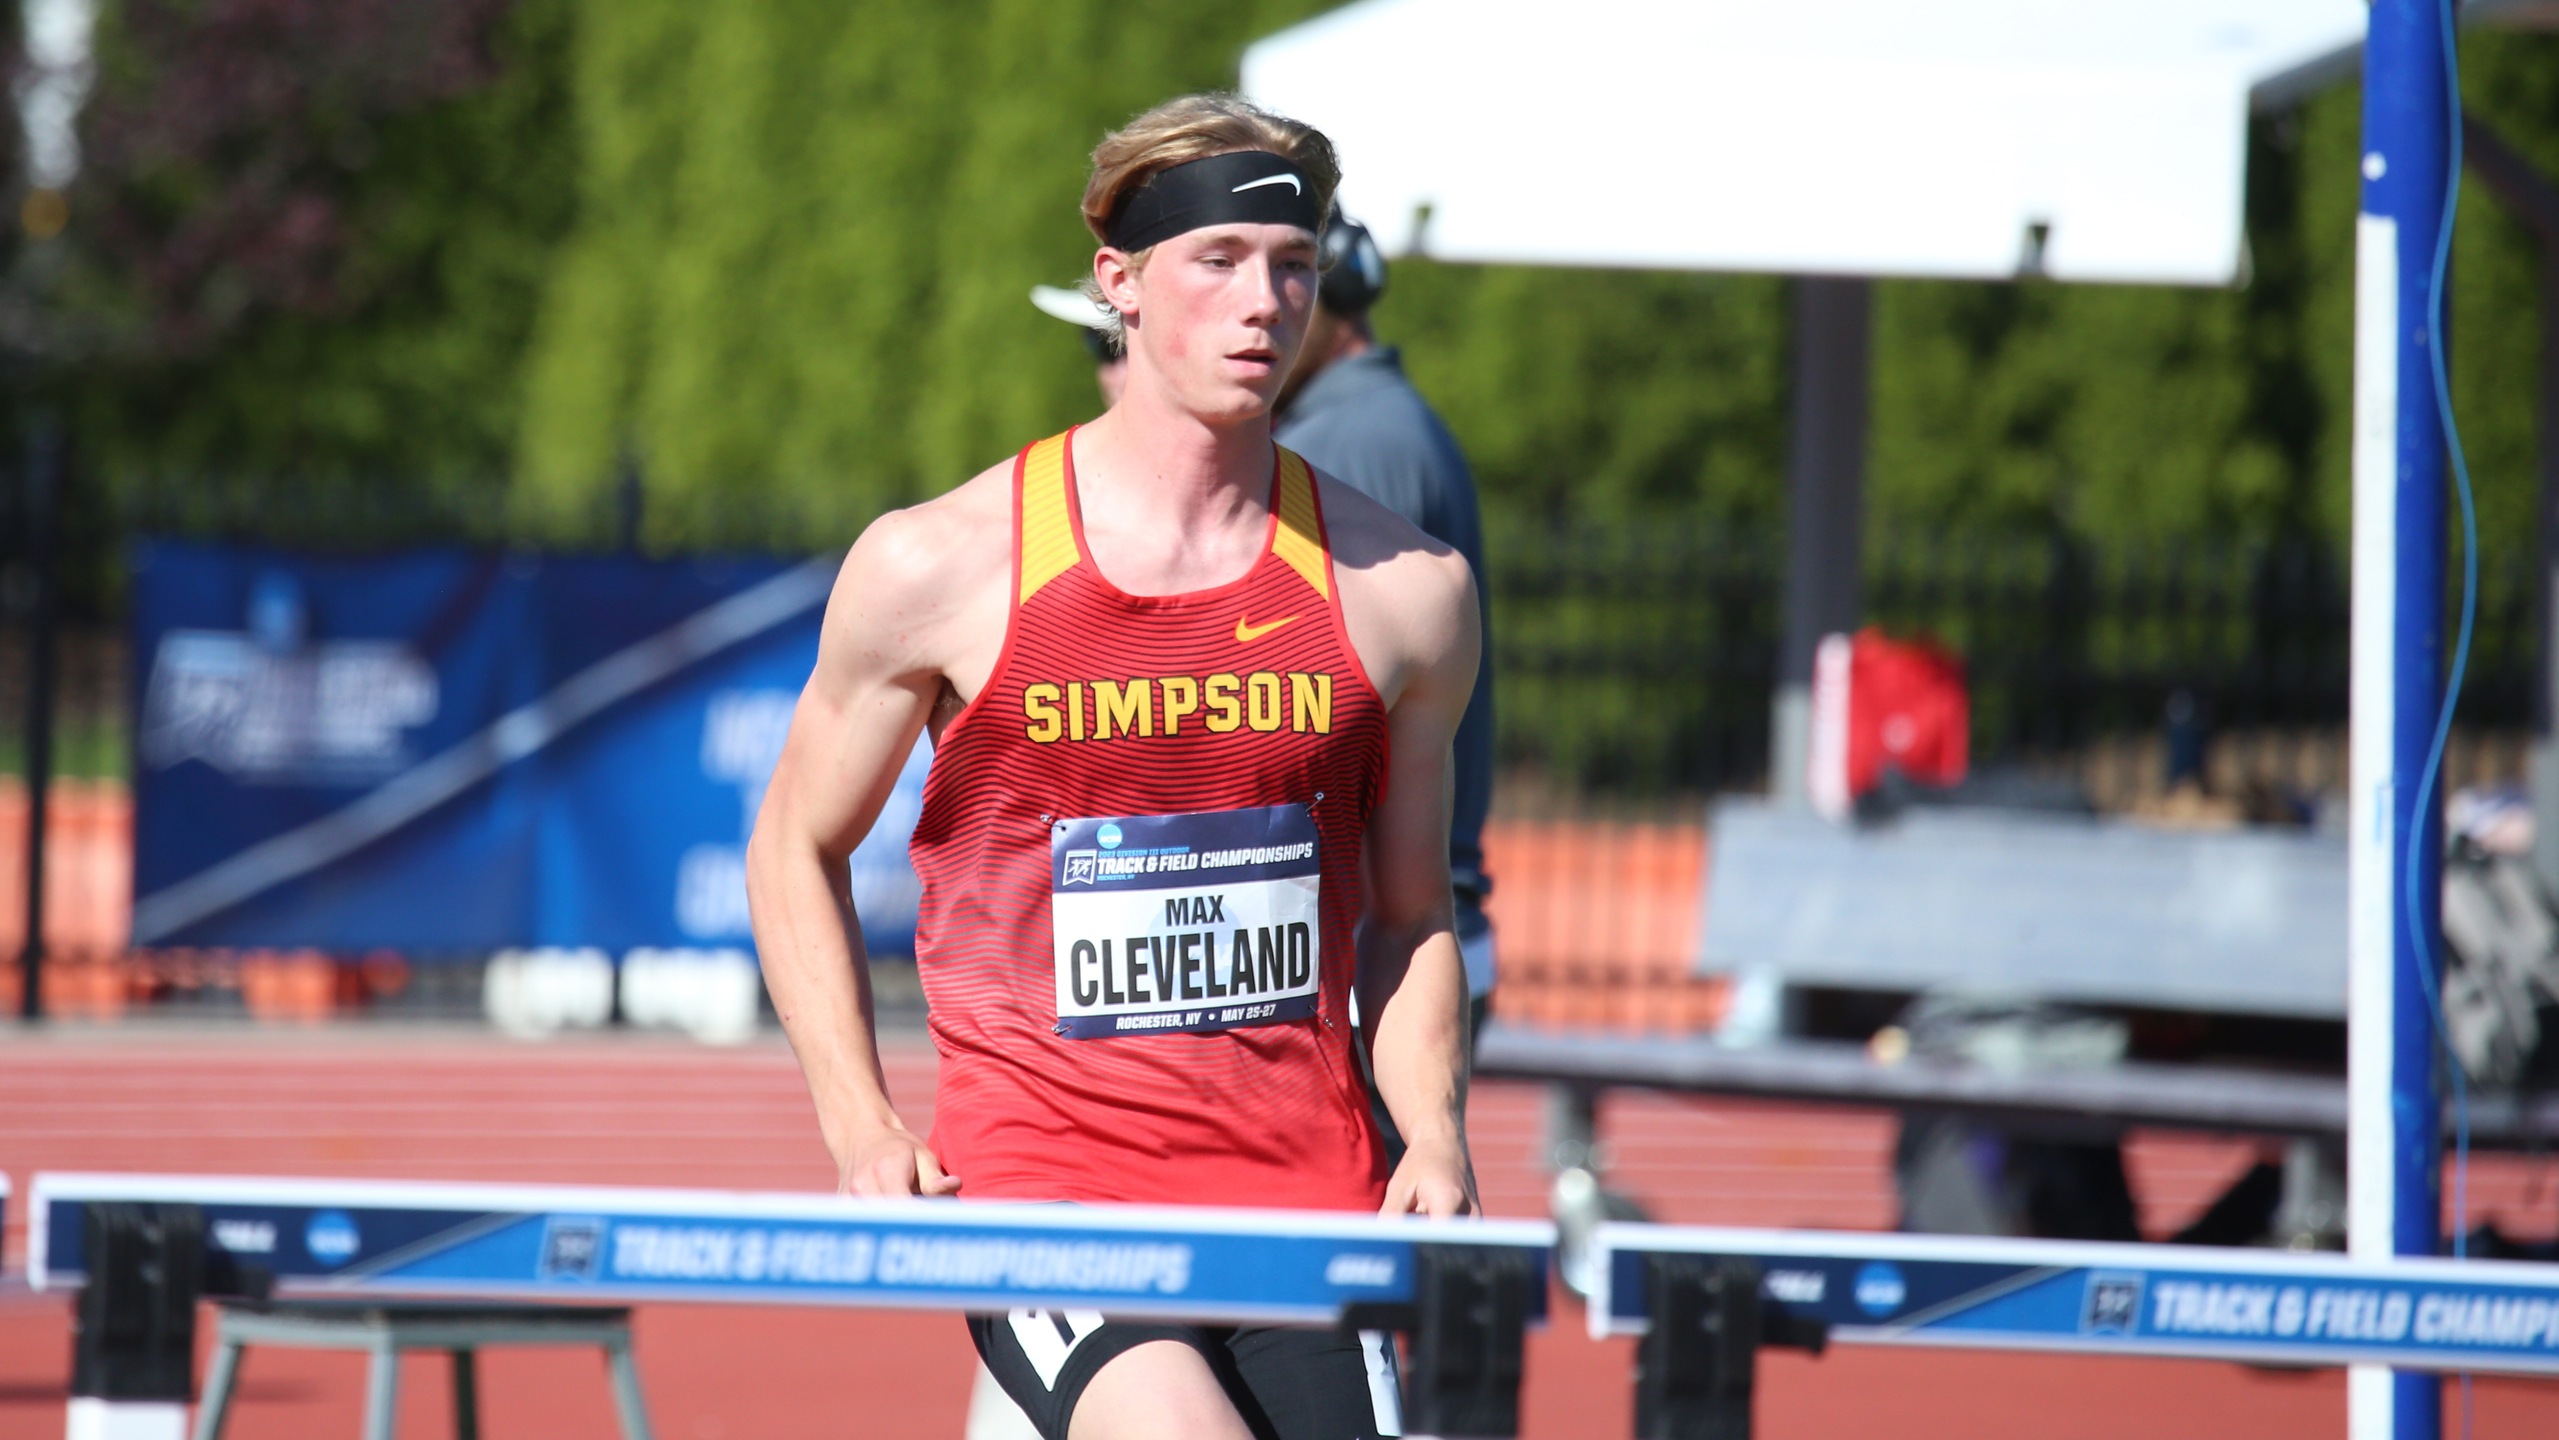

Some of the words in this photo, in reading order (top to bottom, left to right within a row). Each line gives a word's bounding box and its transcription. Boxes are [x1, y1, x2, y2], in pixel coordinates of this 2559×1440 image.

[1024, 671, 1332, 743] SIMPSON
[1098, 856, 1146, 875] TRACK
[1146, 855, 1158, 873] &
[1159, 853, 1199, 872] FIELD
[1201, 842, 1313, 869] CHAMPIONSHIPS
[1117, 849, 1148, 857] DIVISION
[1149, 848, 1159, 856] III
[1160, 847, 1190, 855] OUTDOOR
[1165, 894, 1225, 927] MAX
[1070, 921, 1311, 1007] CLEVELAND
[1116, 1014, 1183, 1030] ROCHESTER,
[1185, 1012, 1202, 1026] NY
[1221, 1008, 1245, 1023] MAY
[1246, 1004, 1277, 1020] 25-27
[613, 1226, 736, 1279] TRACK
[768, 1230, 876, 1284] FIELD
[876, 1233, 1193, 1294] CHAMPIONSHIPS
[2153, 1280, 2276, 1333] TRACK
[2274, 1284, 2305, 1337] &
[2305, 1287, 2409, 1342] FIELD
